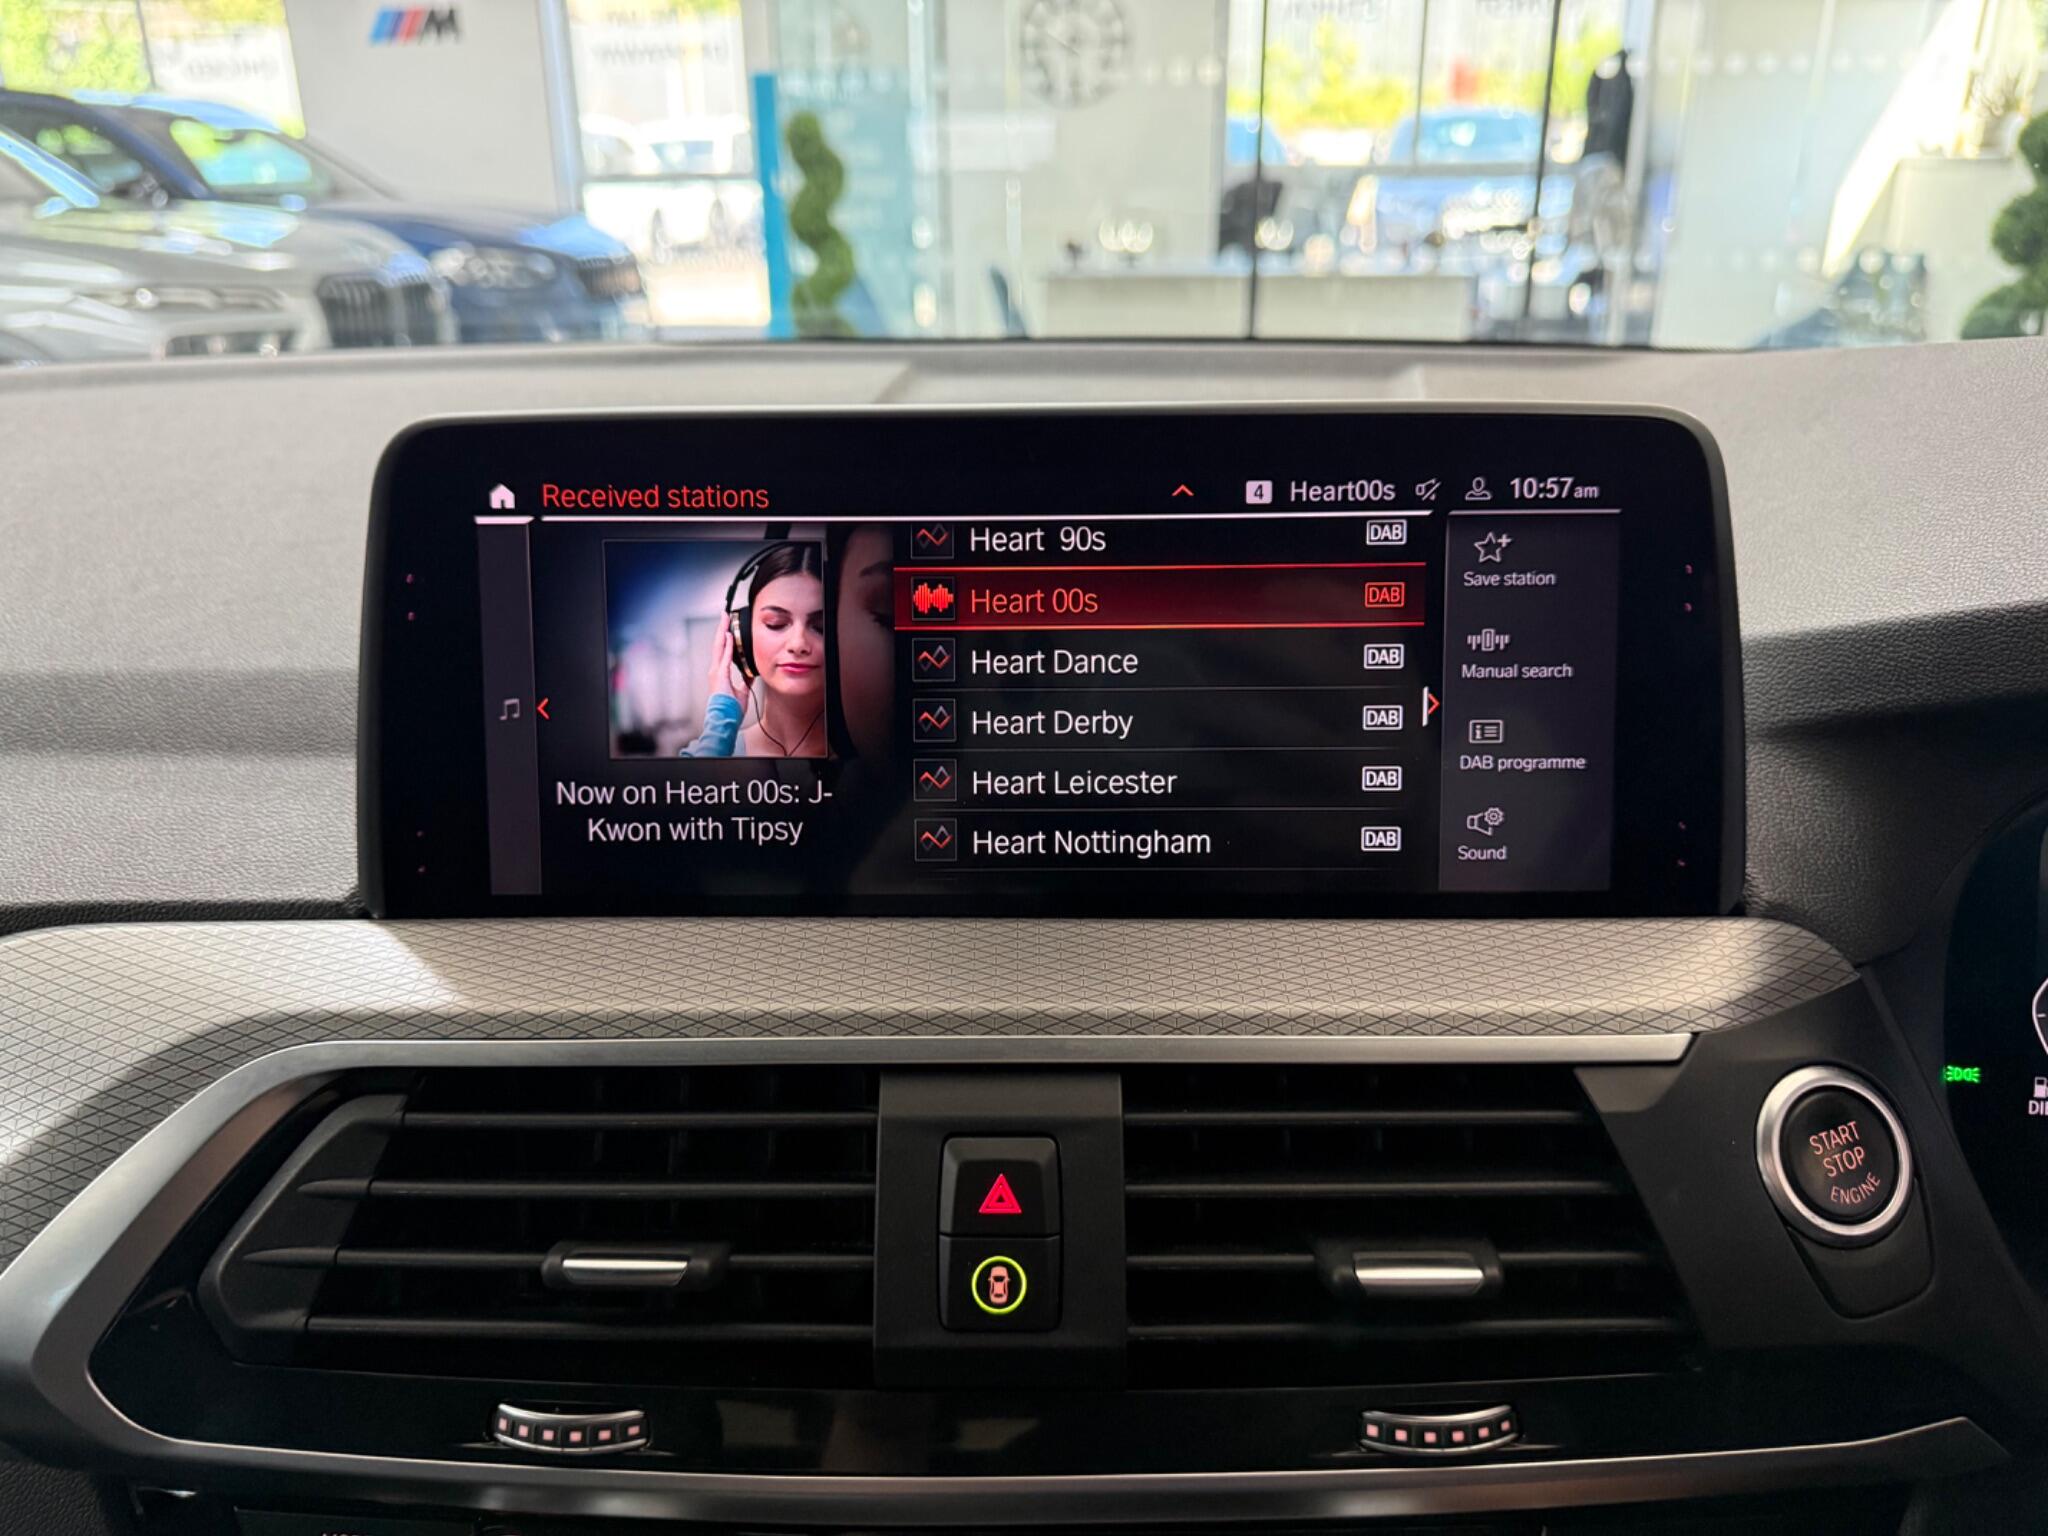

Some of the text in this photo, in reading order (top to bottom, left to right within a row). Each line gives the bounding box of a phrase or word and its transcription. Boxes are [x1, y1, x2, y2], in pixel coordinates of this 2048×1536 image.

[542, 484, 769, 509] Received stations
[1290, 480, 1396, 502] Heart00s
[970, 527, 1107, 552] Heart 90s
[1370, 524, 1402, 541] DAB
[1463, 571, 1556, 587] Save station
[971, 588, 1099, 614] Heart 00s
[1368, 587, 1400, 603] DAB
[972, 650, 1139, 675] Heart Dance
[1367, 648, 1399, 665] DAB
[1461, 663, 1573, 679] Manual search
[973, 710, 1134, 740] Heart Derby
[1366, 709, 1398, 726] DAB
[1460, 755, 1586, 773] DAB programme
[973, 771, 1178, 795] Heart Leicester
[1366, 771, 1398, 787] DAB
[556, 780, 833, 805] Now on Heart 00s: J-
[588, 816, 804, 846] Kwon with Tipsy
[1365, 831, 1397, 847] DAB
[974, 830, 1211, 860] Heart Nottingham
[1457, 845, 1507, 861] Sound
[1809, 1121, 1860, 1155] START
[1823, 1146, 1865, 1178] STOP
[1830, 1172, 1881, 1206] ENGINE
